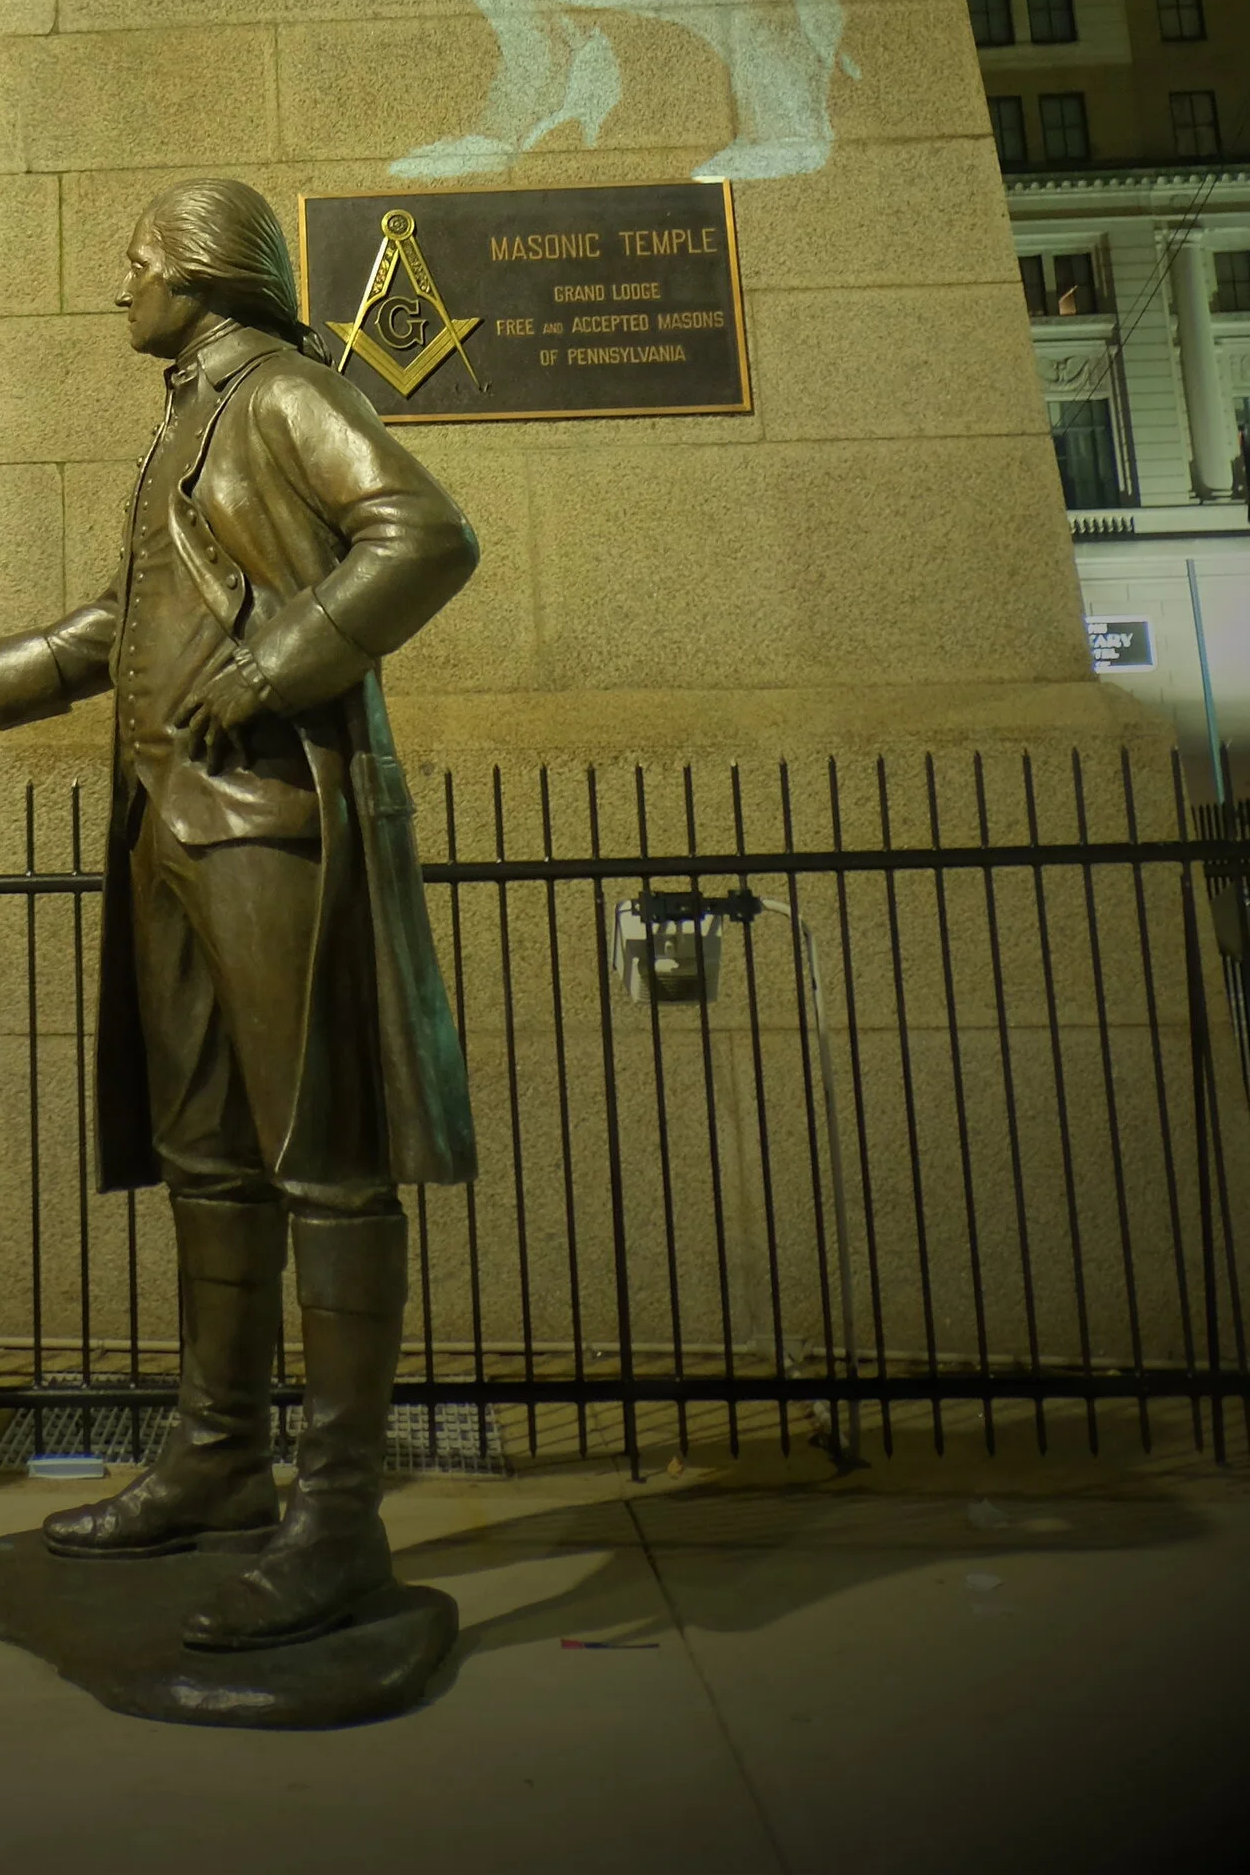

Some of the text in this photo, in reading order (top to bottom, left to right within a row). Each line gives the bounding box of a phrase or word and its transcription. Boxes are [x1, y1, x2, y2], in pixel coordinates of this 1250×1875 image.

[490, 228, 718, 261] MASONIC TEMPLE
[554, 282, 661, 303] GRAND LODGE
[374, 296, 428, 348] G
[496, 311, 724, 336] FREE AND ACCEPTED MASONS
[540, 345, 686, 366] OF PENNSYLVANIA
